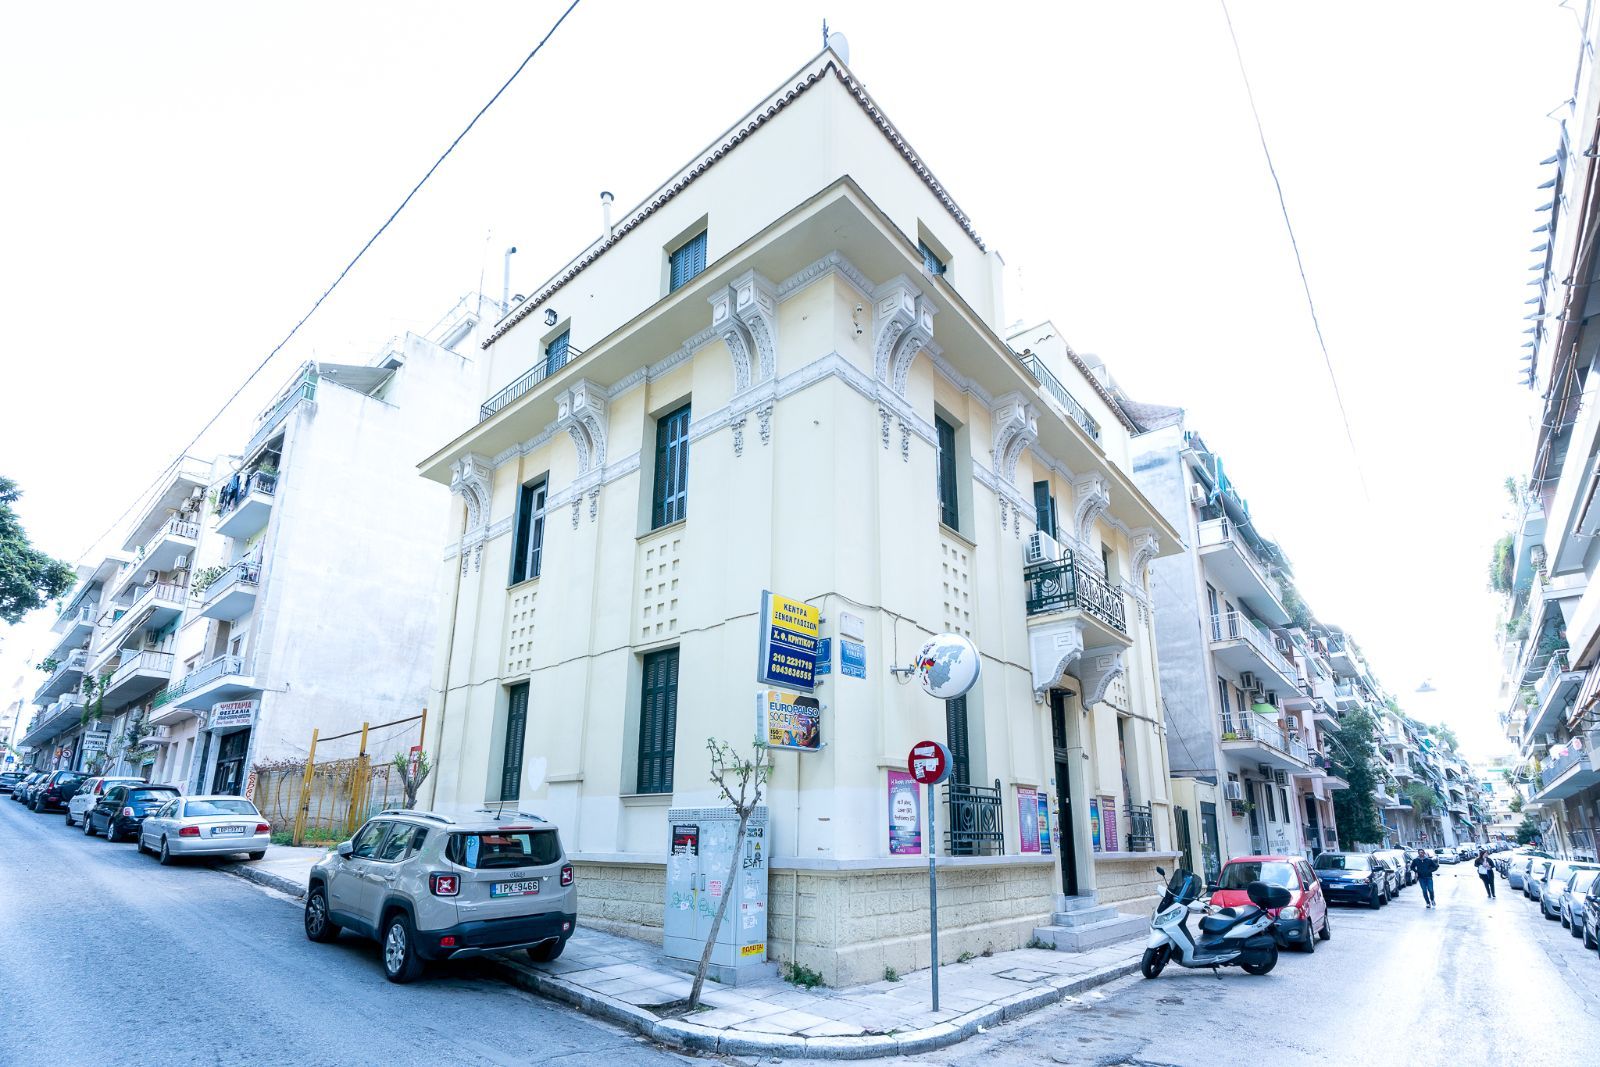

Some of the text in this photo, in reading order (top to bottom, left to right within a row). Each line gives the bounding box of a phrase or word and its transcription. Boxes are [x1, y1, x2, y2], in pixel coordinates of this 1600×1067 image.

[784, 604, 807, 617] ΚΕΝΤΡΑ
[773, 653, 786, 664] 210
[769, 701, 819, 717] EUROPALSO
